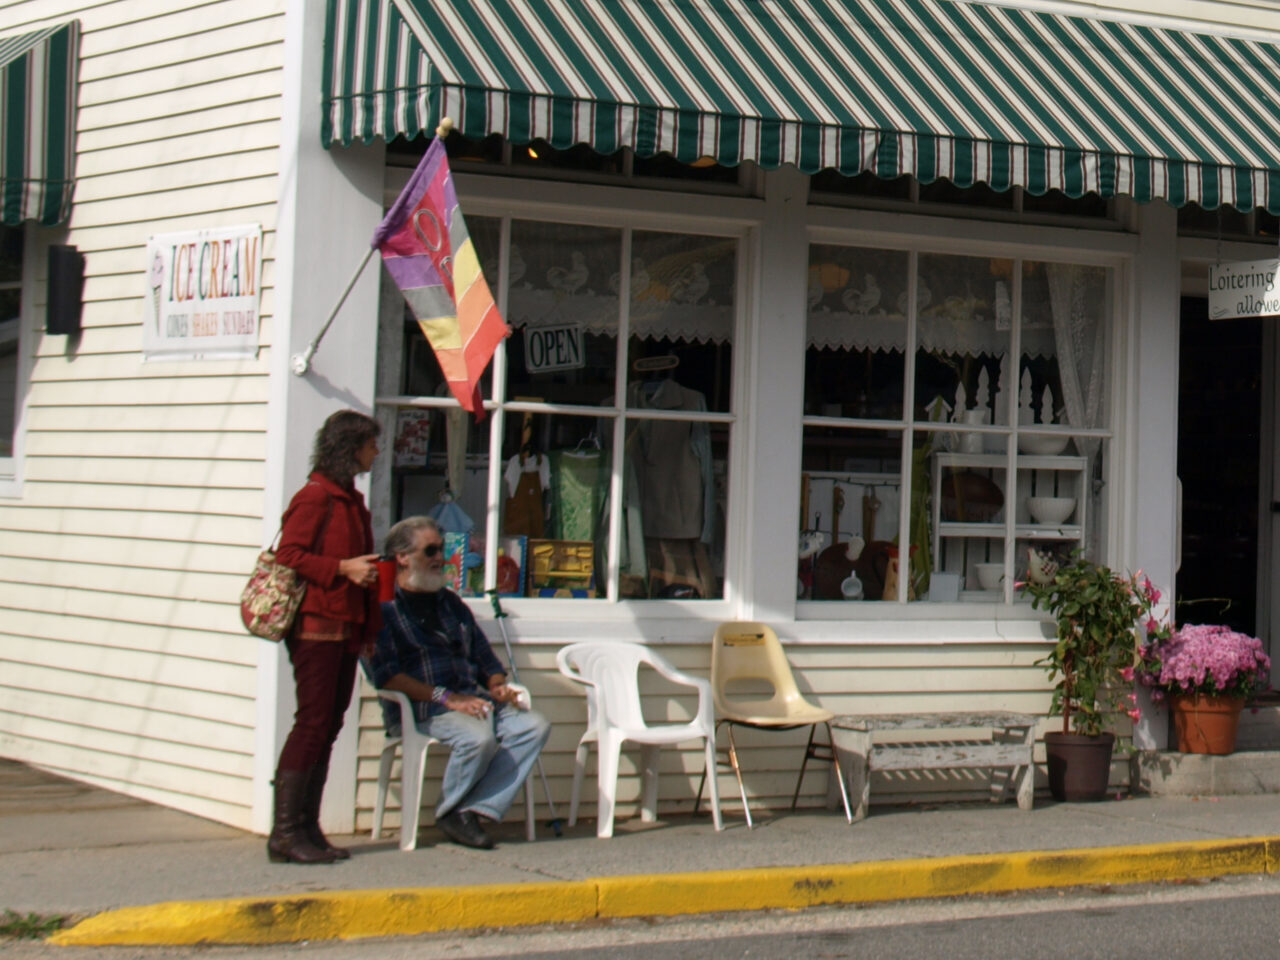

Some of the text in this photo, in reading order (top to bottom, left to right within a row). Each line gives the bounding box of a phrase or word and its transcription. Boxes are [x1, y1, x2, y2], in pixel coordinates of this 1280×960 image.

[169, 236, 259, 303] ICE CREAM
[1209, 266, 1276, 292] Loitering
[529, 325, 582, 368] OPEN
